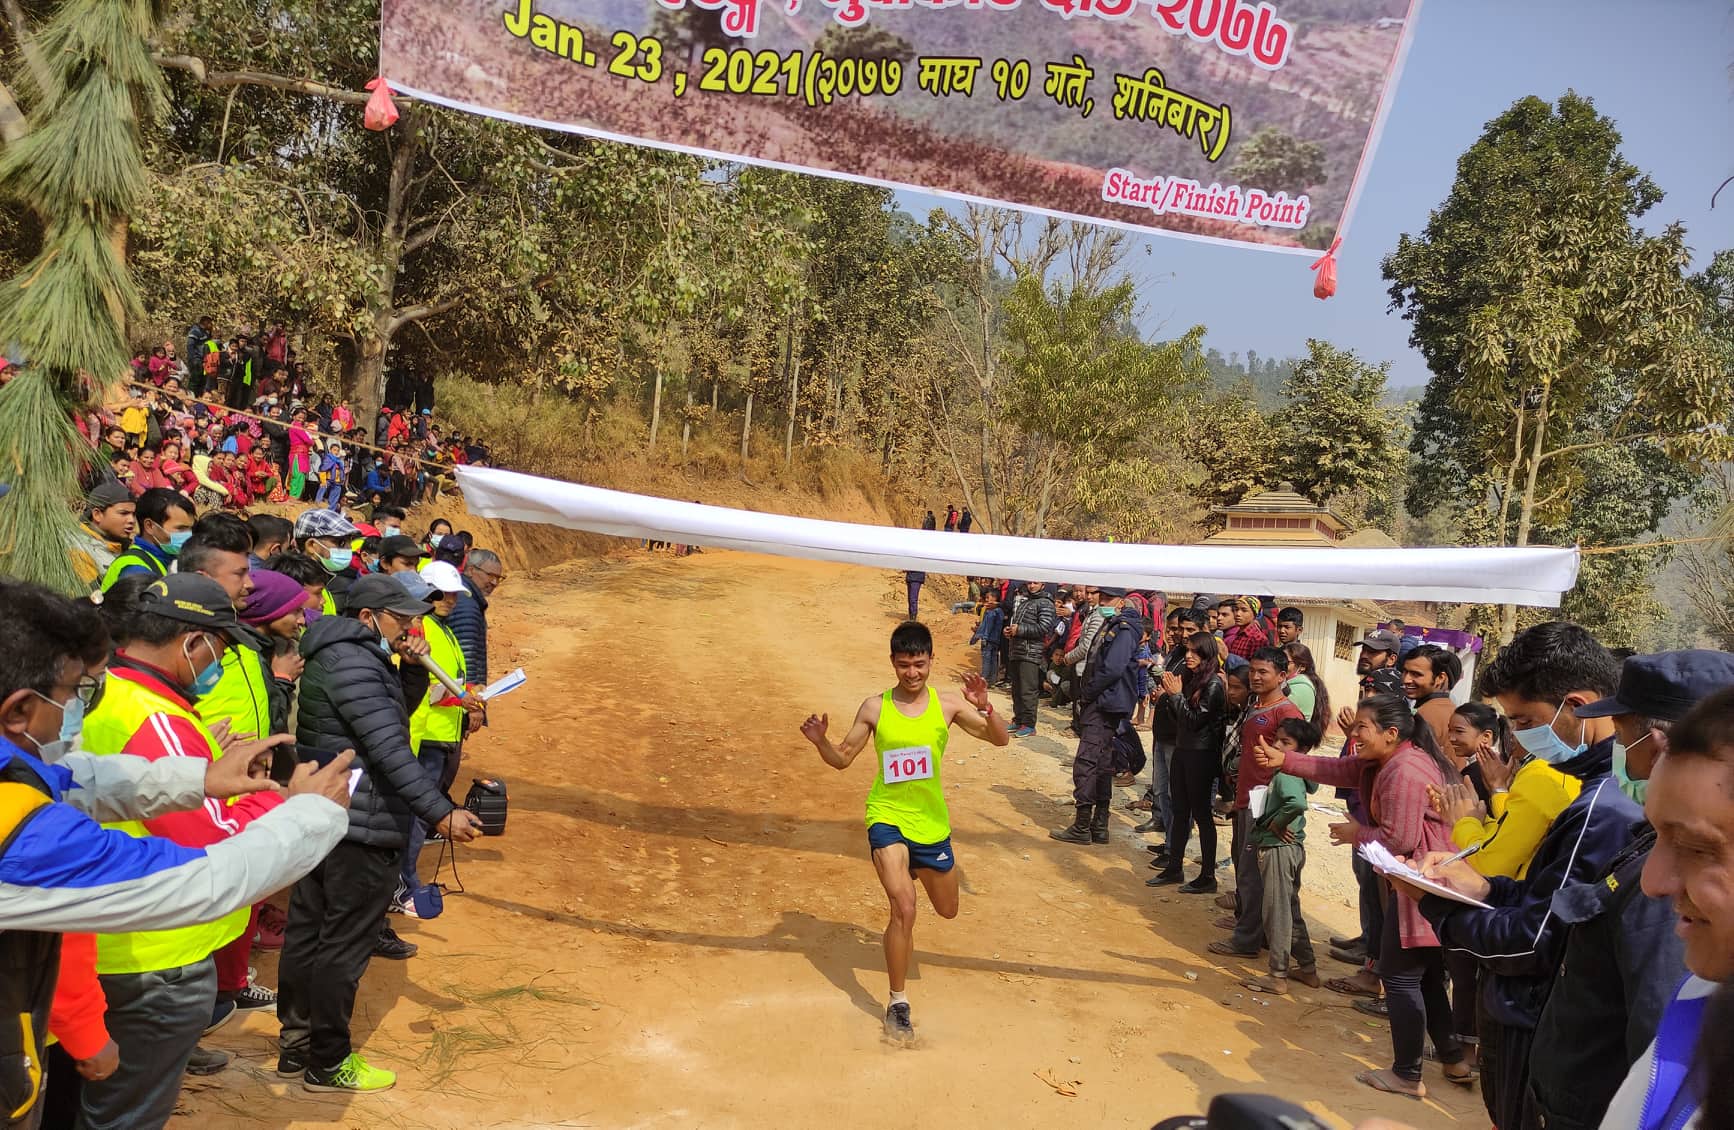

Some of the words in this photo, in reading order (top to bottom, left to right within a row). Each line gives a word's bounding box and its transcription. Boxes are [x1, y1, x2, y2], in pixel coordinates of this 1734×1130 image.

[505, 0, 597, 67] Jan.
[919, 58, 981, 96] माघ
[992, 60, 1030, 99] १०
[1106, 172, 1239, 217] Start/Finish
[1245, 193, 1306, 225] Point
[889, 756, 928, 777] 101
